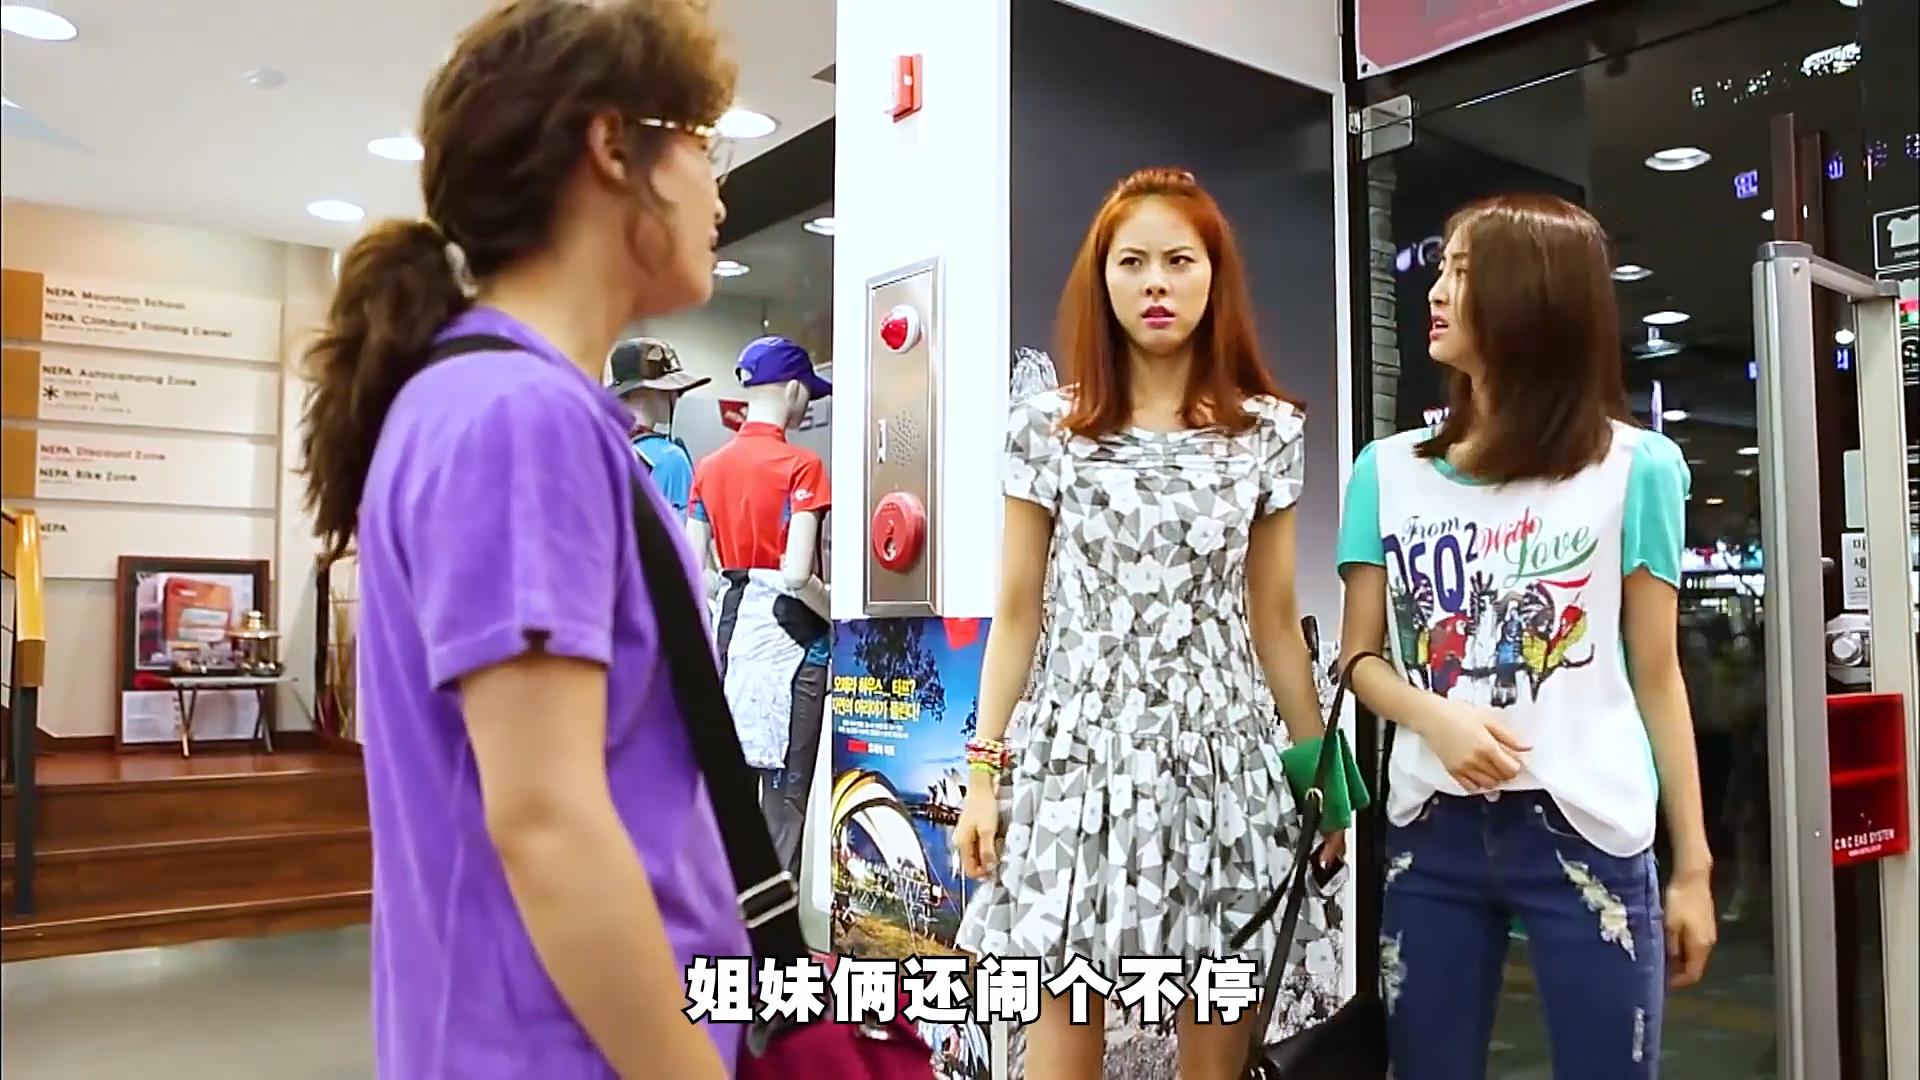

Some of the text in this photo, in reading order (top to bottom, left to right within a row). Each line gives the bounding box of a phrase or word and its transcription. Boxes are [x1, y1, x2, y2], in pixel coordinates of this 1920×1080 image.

[45, 286, 76, 298] NEPA
[82, 290, 141, 306] Mountain
[145, 297, 186, 310] School
[45, 311, 75, 323] NEPA
[81, 315, 137, 331] Climbing
[141, 321, 189, 336] Training
[193, 326, 233, 339] Center
[42, 365, 73, 376] NEPA
[79, 368, 164, 385] Autocamping
[167, 376, 197, 387] Zone
[39, 444, 166, 461] NEPA Discount Zone
[39, 468, 137, 482] NEPA Bike Zone
[1401, 515, 1460, 544] From
[1503, 515, 1598, 588] Love
[1869, 828, 1895, 844] SYSTEM
